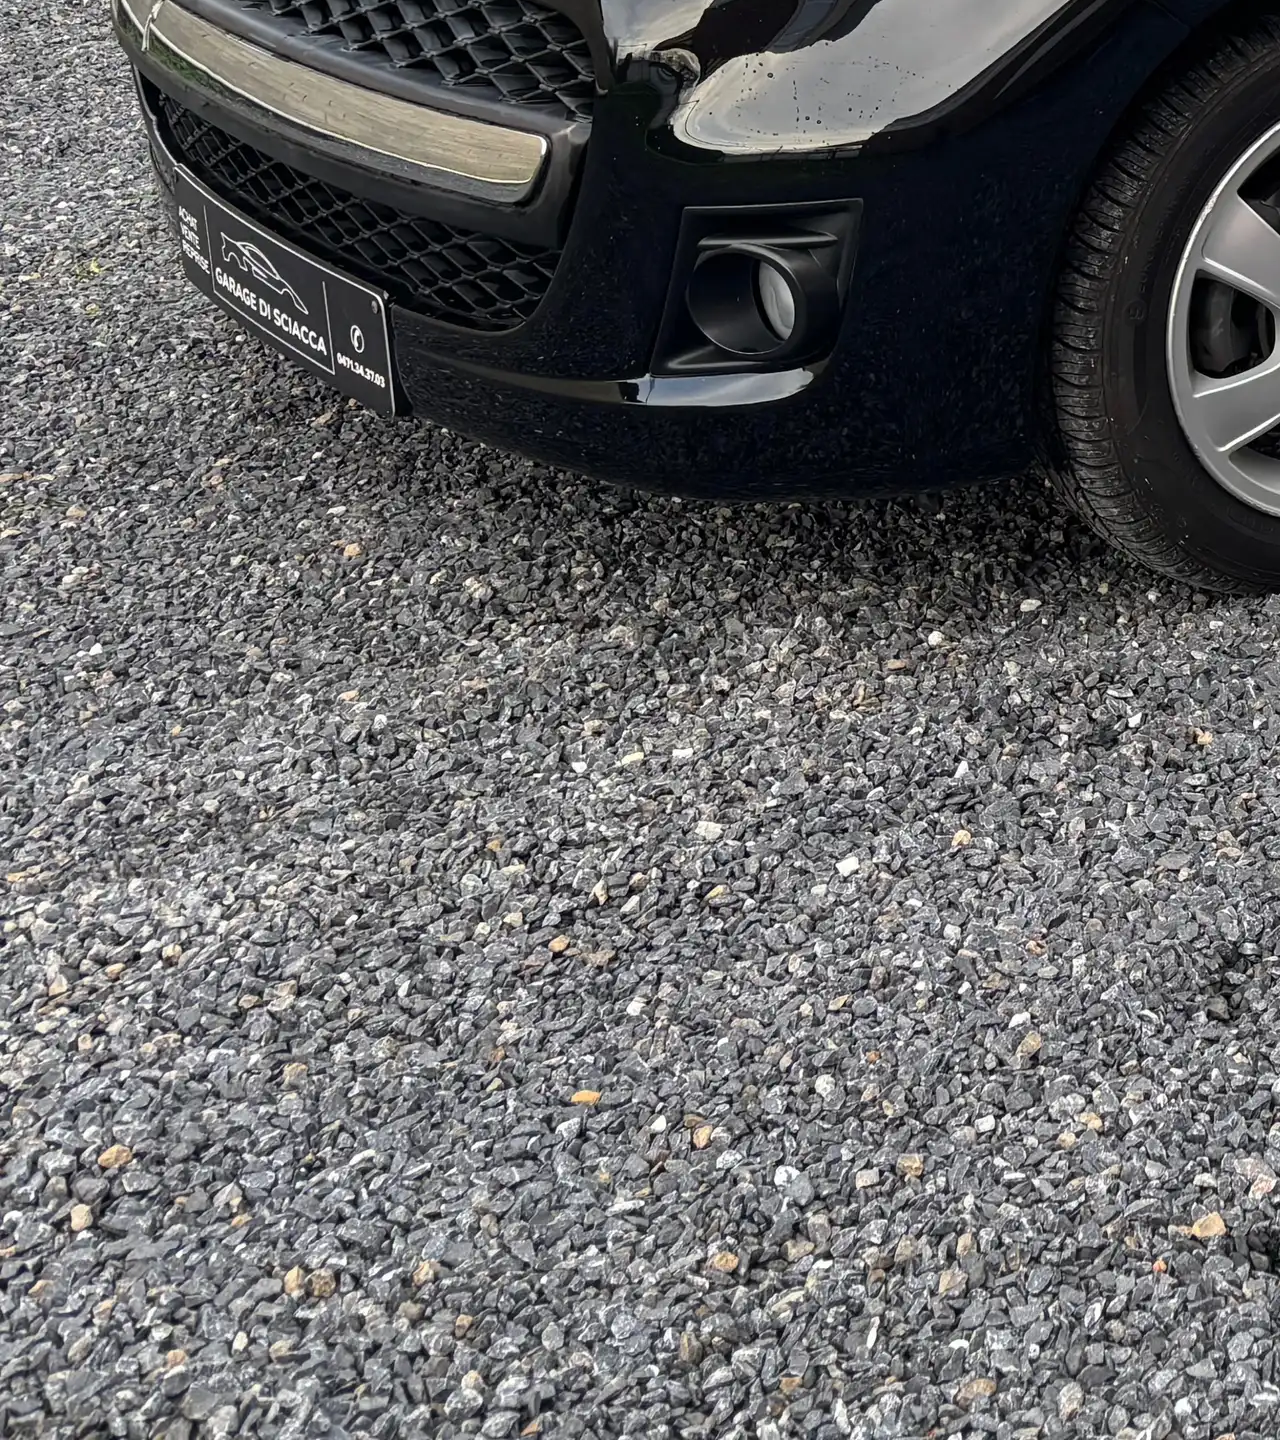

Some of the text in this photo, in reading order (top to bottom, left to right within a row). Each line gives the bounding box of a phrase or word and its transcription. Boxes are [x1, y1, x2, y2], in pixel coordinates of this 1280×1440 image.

[215, 267, 327, 356] GARAGE DI SCIACCA
[336, 352, 386, 388] 0471.34.37.03
